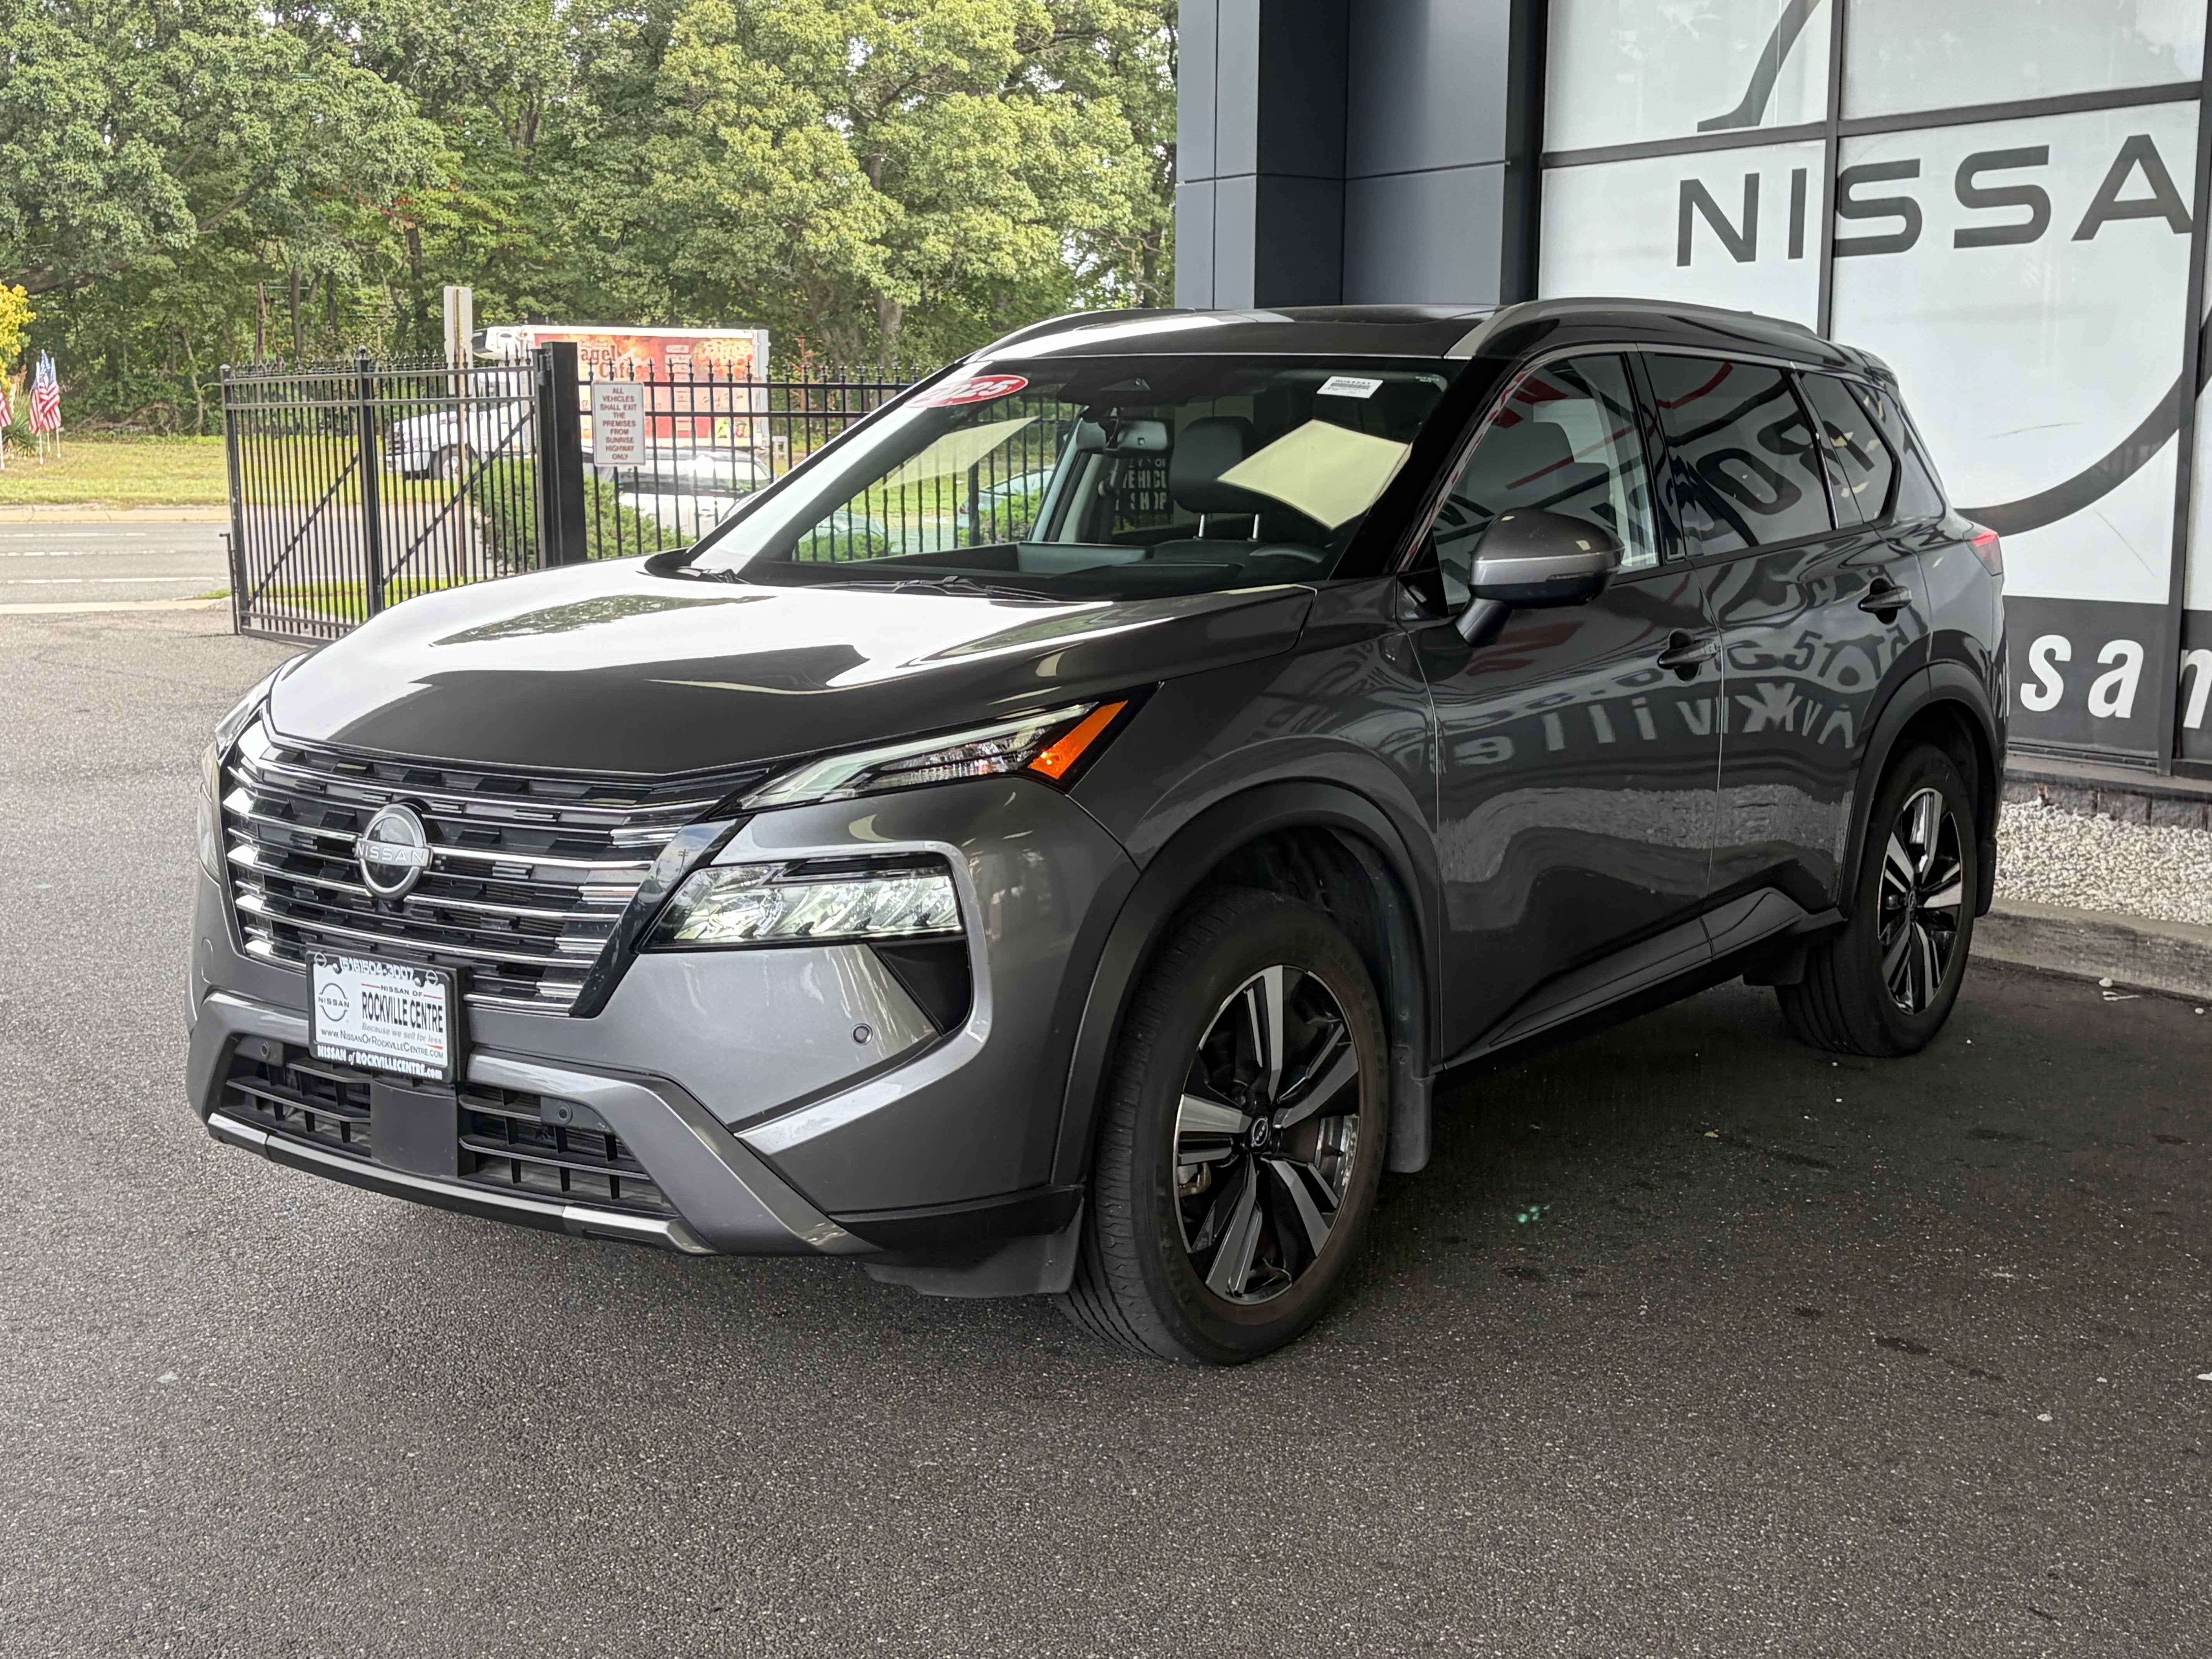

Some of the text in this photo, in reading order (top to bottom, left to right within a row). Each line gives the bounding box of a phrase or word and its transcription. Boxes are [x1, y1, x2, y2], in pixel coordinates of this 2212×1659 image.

[356, 842, 425, 864] NISSAN
[381, 984, 409, 995] NISSAN
[318, 996, 349, 1008] NISSAN
[362, 991, 443, 1033] ROCKVILLE CENTRE
[362, 1022, 390, 1035] Because
[404, 1032, 415, 1040] sell
[417, 1033, 426, 1041] for
[317, 1044, 347, 1061] NISSAN
[348, 1051, 356, 1065] of
